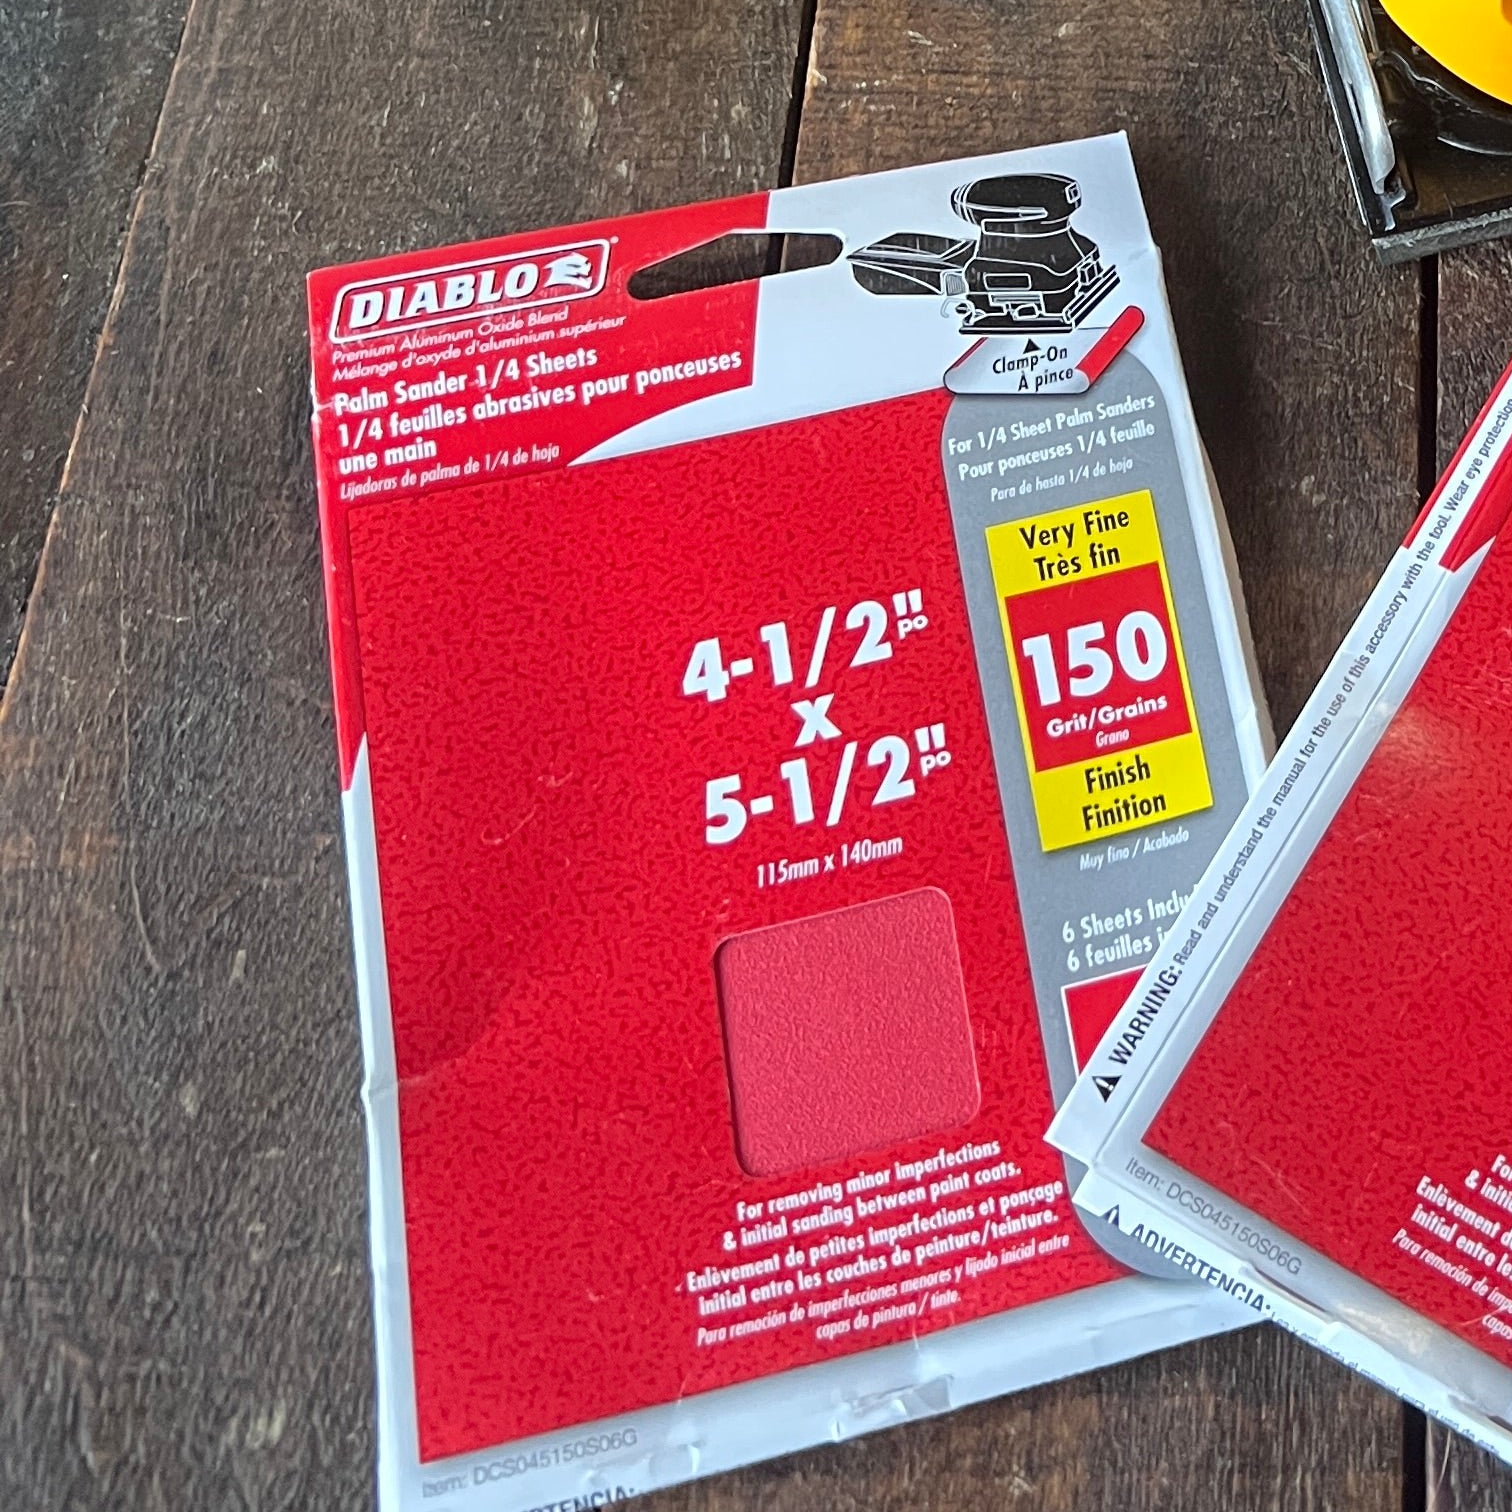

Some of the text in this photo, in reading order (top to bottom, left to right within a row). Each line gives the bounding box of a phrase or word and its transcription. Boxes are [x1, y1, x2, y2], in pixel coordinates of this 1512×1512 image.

[349, 263, 538, 330] DIABLO
[332, 305, 568, 364] Premium Aluminum Oxide Blend
[394, 370, 467, 404] Sander
[474, 358, 520, 389] 1/4
[526, 347, 597, 377] Sheets
[338, 351, 741, 449] 1/4 feuilles abrasives pour ponceuses
[948, 394, 1155, 455] For 1/4 Sheet Palm Sanders
[339, 437, 436, 474] une main
[958, 419, 1154, 480] Pour ponceuses 1/4 feuille
[1465, 457, 1482, 479] eye
[1443, 479, 1469, 510] Wear
[1019, 510, 1129, 549] Very Fine
[1428, 514, 1451, 539] tool.
[1033, 542, 1120, 581] Très fin
[1416, 540, 1435, 561] the
[1401, 563, 1423, 589] with
[897, 615, 927, 639] po
[1365, 590, 1407, 654] accessory
[1022, 610, 1168, 707] 150
[1348, 654, 1370, 678] this
[1342, 675, 1355, 692] of
[1046, 695, 1167, 737] Grit/Grains
[1326, 693, 1346, 716] use
[1311, 716, 1331, 737] the
[920, 750, 951, 776] po
[1299, 737, 1318, 758] for
[1084, 754, 1150, 793] Finish
[1272, 757, 1306, 806] manual
[1082, 794, 1166, 831] Finition
[1256, 807, 1277, 828] the
[757, 837, 902, 887] 115mm x 140mm
[1214, 827, 1263, 902] understand
[1197, 901, 1218, 929] and
[1172, 928, 1202, 965] Read
[1108, 965, 1182, 1064] WARNING:
[1464, 1169, 1479, 1189] &
[1125, 1157, 1302, 1275] Item: DCS045150S06G
[1416, 1175, 1500, 1238] Enlèvement
